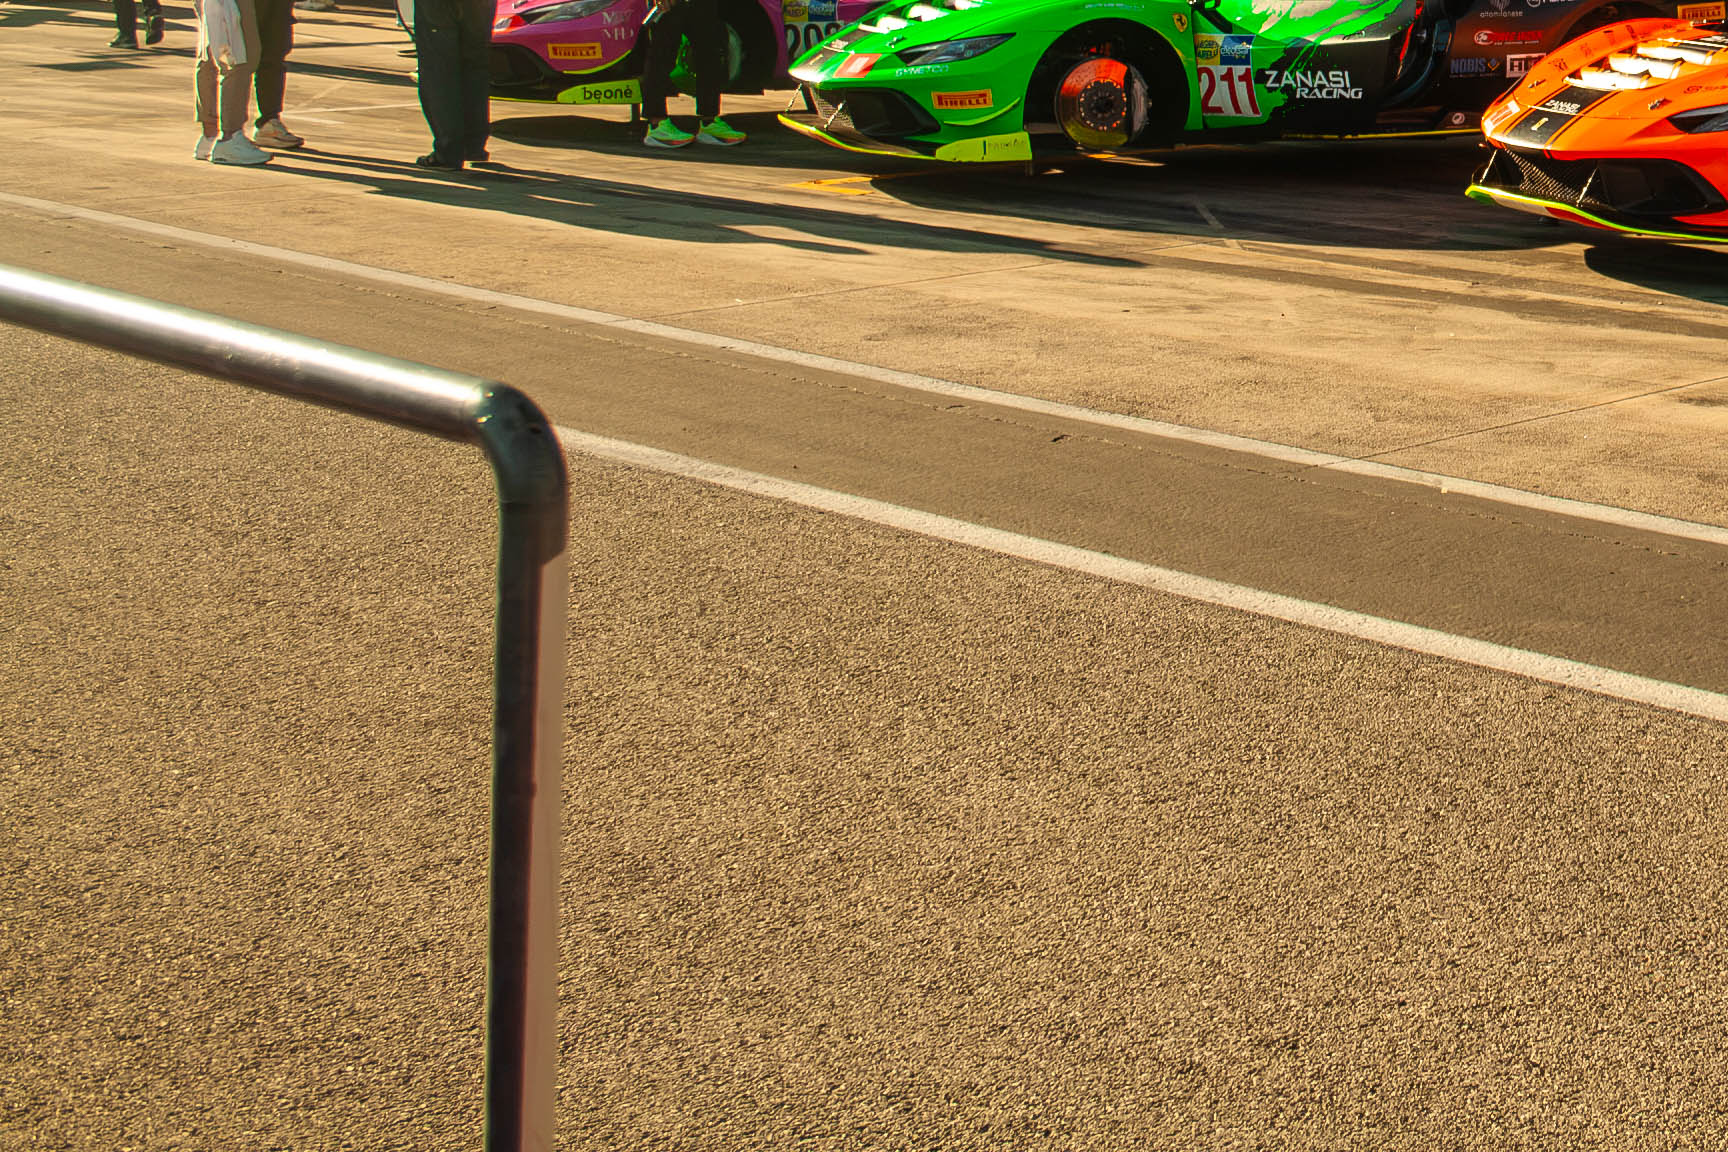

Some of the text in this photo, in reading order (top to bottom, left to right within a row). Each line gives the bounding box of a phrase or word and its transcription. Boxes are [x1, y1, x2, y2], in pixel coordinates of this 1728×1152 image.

[551, 46, 598, 57] PIRELLI
[1265, 70, 1351, 88] ZANASI
[1199, 66, 1261, 116] 211
[1296, 87, 1363, 99] RACING
[936, 92, 988, 108] PIRELLI
